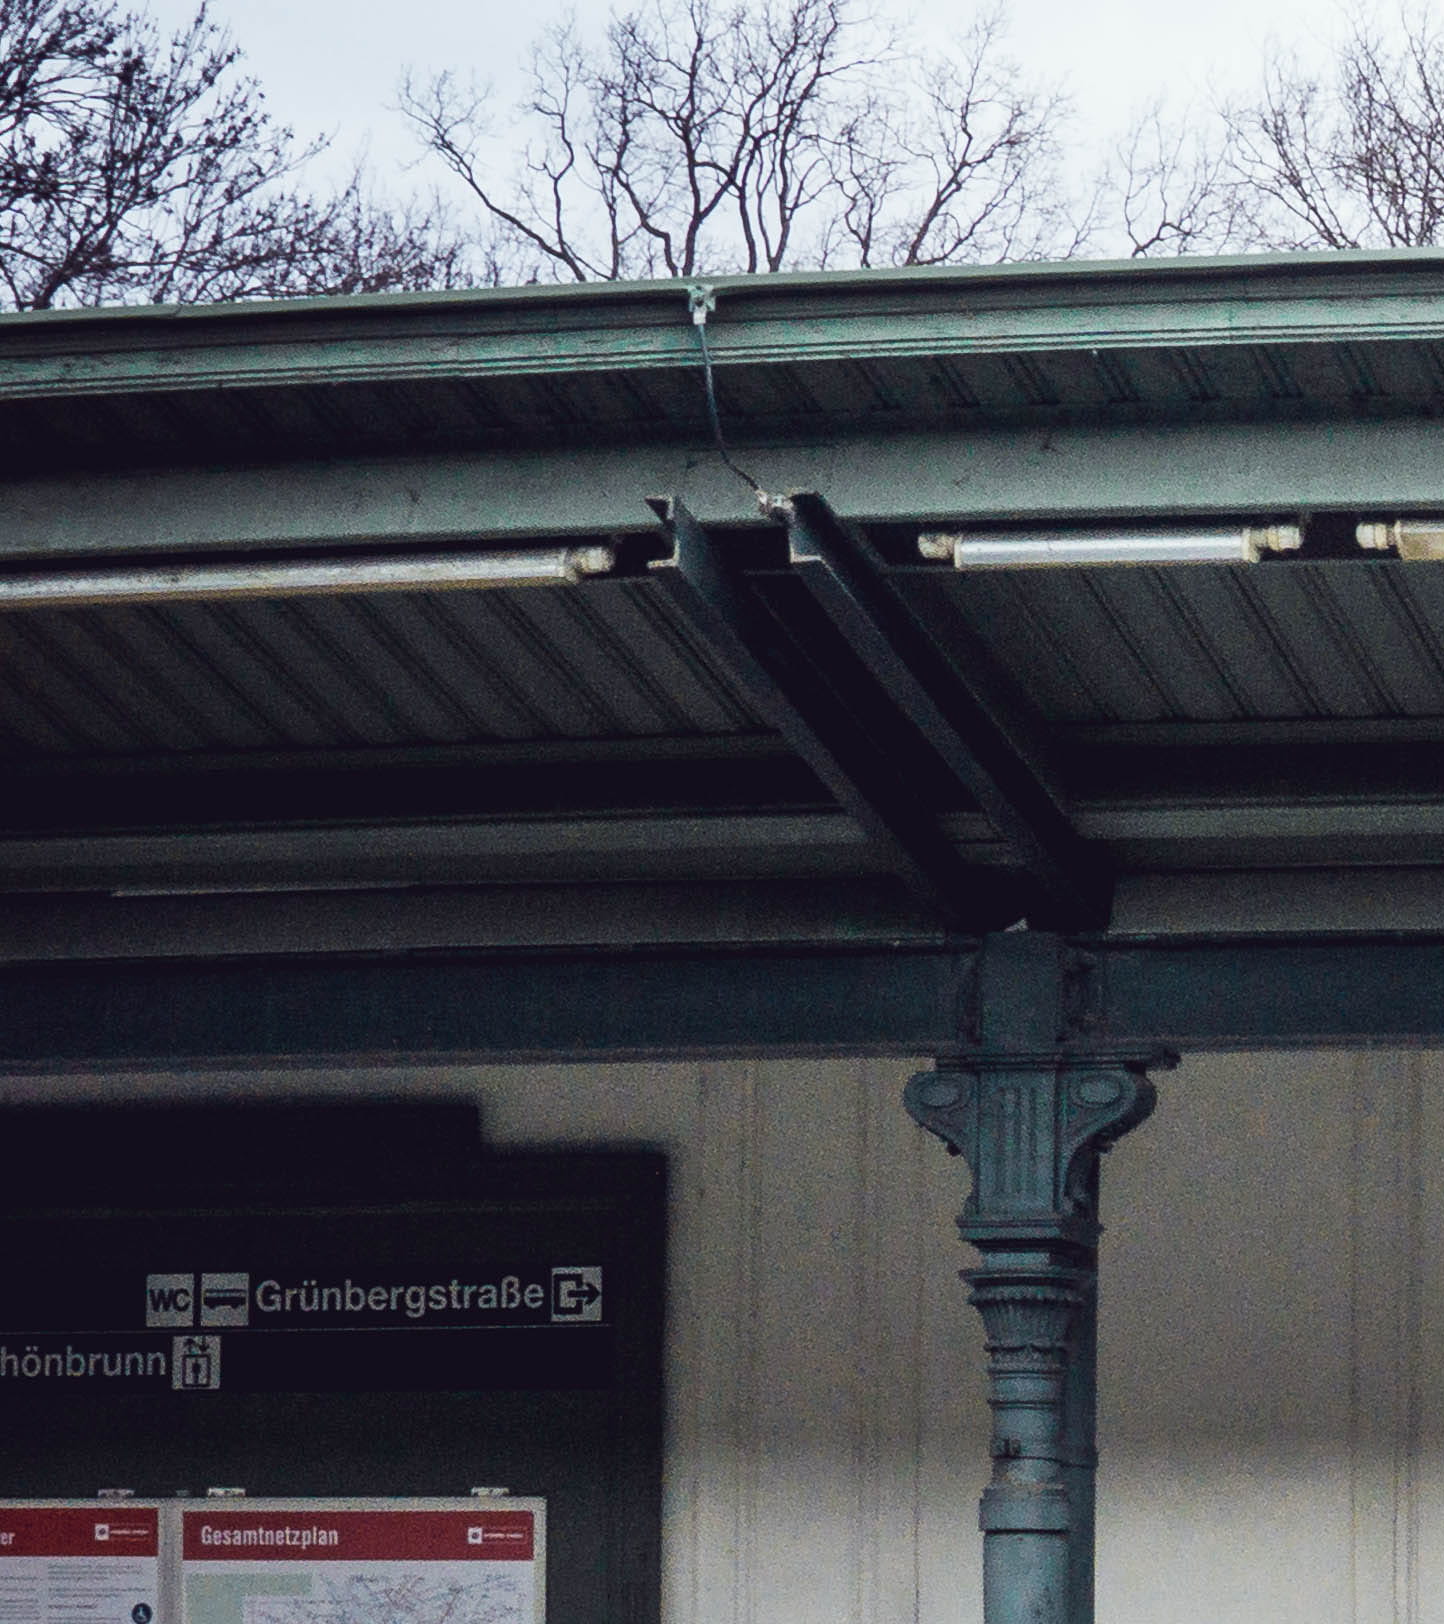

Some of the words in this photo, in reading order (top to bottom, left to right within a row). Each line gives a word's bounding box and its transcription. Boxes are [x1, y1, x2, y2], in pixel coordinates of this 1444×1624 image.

[149, 1288, 191, 1312] WC
[256, 1276, 544, 1318] Grünbergstraße
[201, 1526, 339, 1549] Gesamtnetzplan
